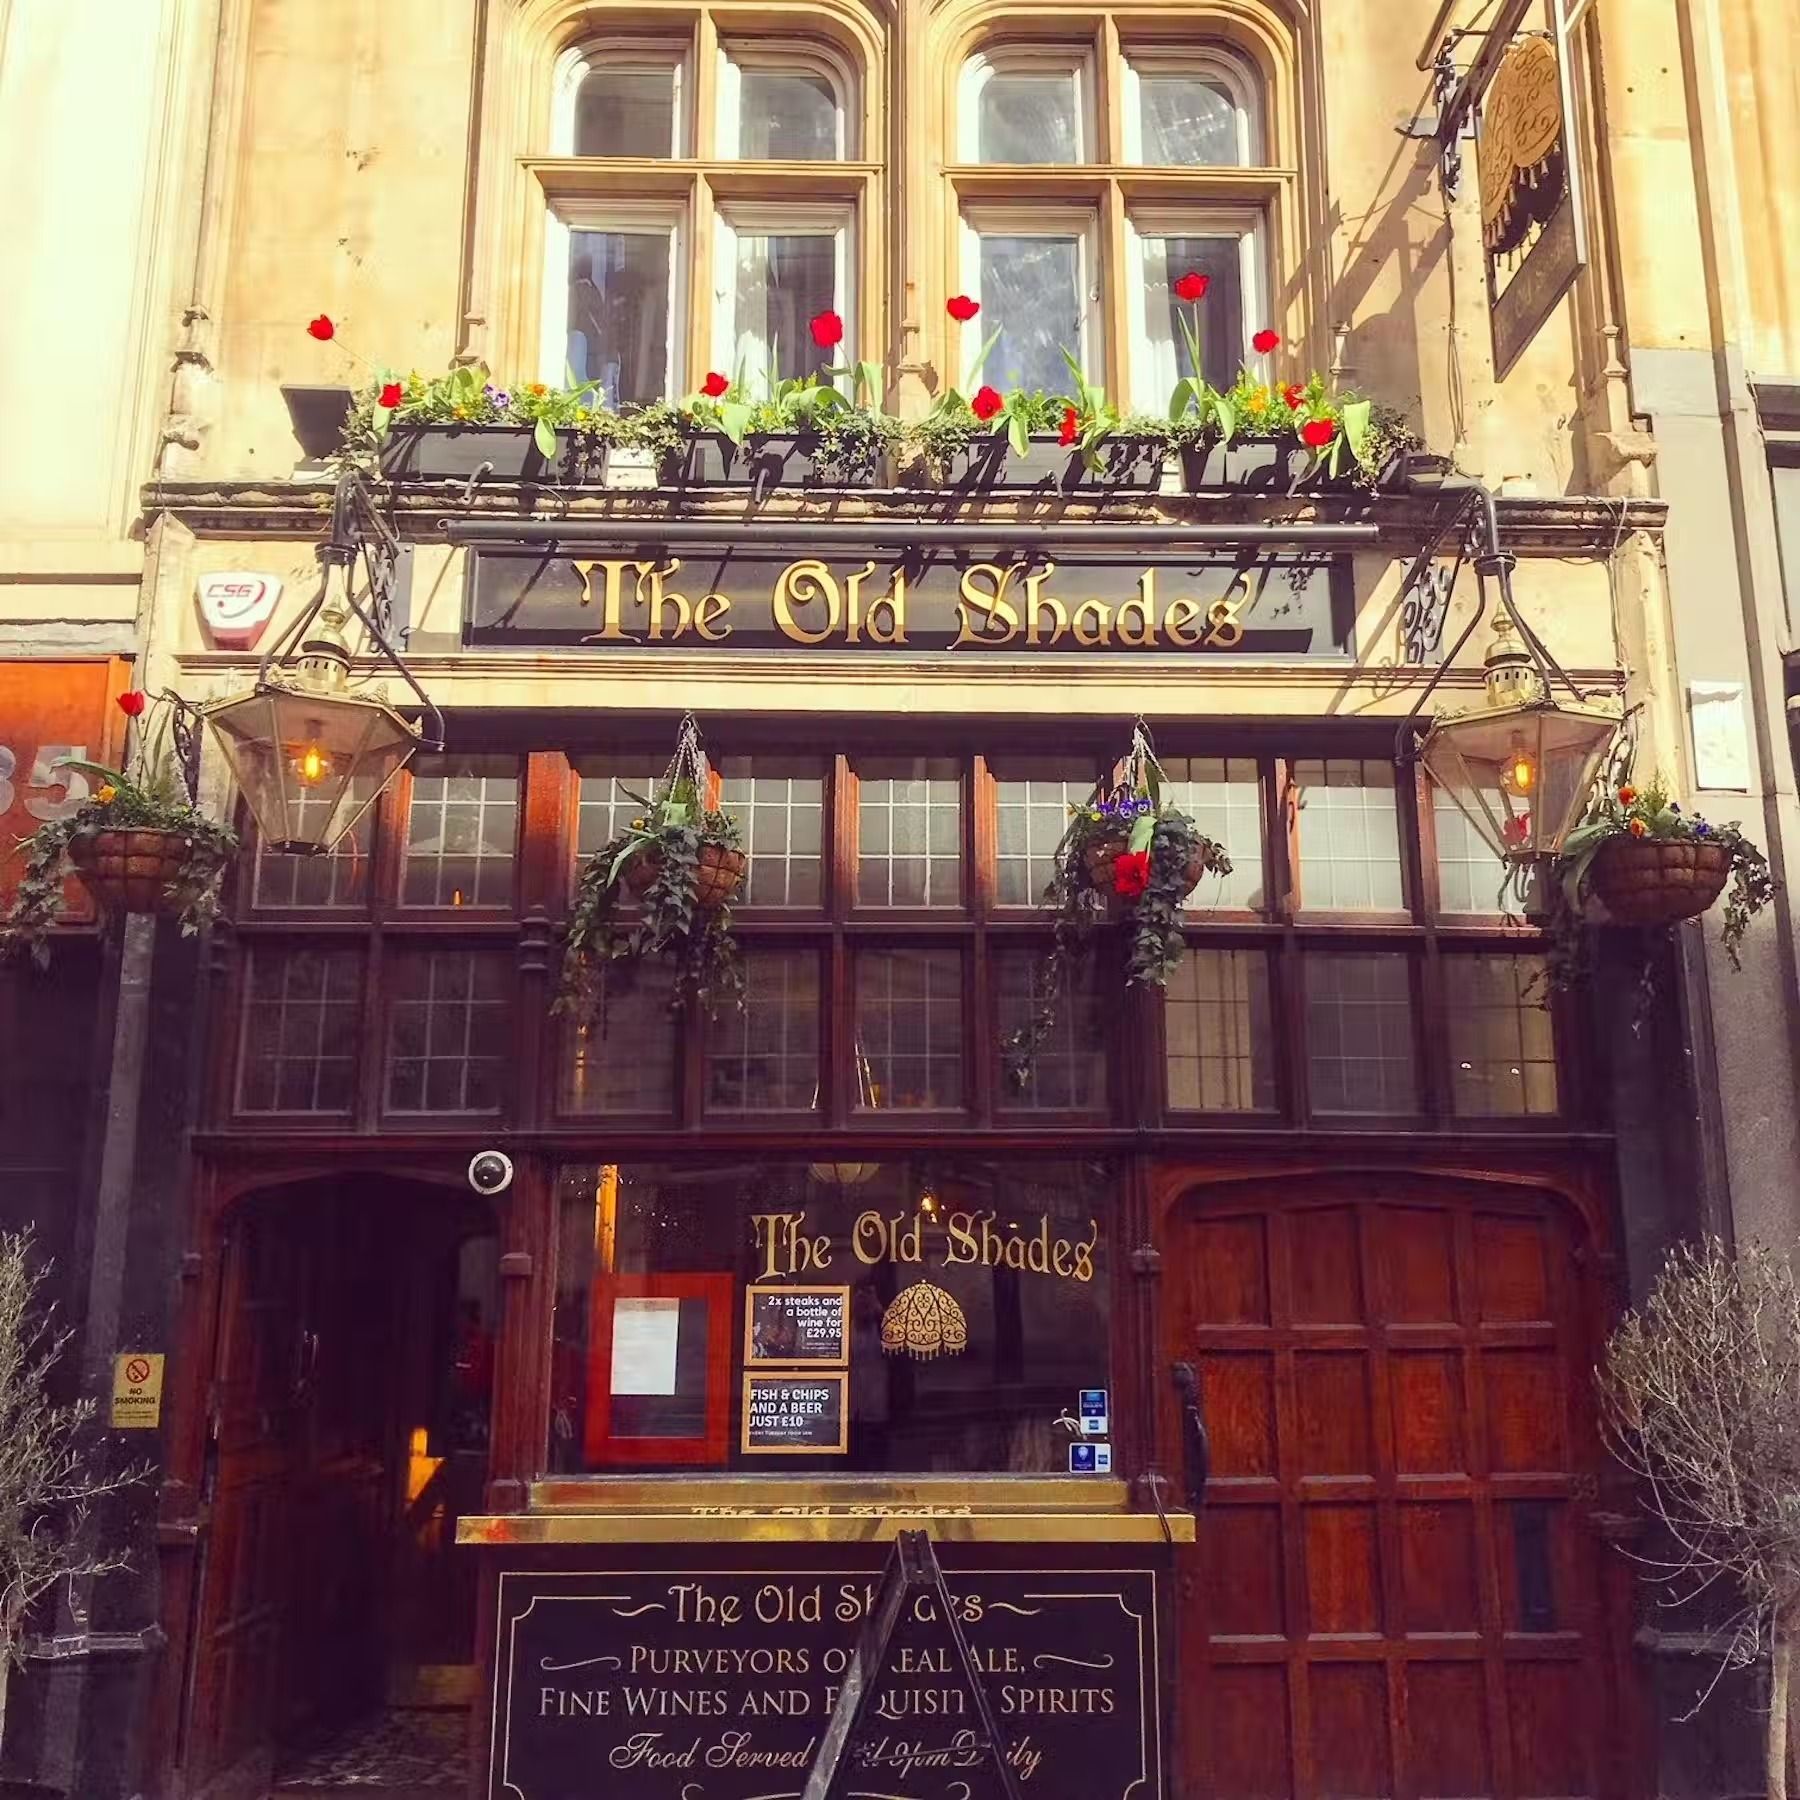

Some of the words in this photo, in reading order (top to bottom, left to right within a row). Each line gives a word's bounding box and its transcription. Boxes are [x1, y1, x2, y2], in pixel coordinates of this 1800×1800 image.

[572, 557, 733, 644] The
[773, 559, 909, 644] Old
[946, 561, 1251, 650] Shades
[751, 1211, 832, 1283] The
[852, 1210, 923, 1264] Old
[941, 1209, 1098, 1283] Shades
[768, 1295, 782, 1306] 2x
[784, 1295, 820, 1306] steaks
[821, 1295, 843, 1306] and
[786, 1308, 794, 1317] a
[796, 1306, 828, 1317] bottle
[830, 1306, 843, 1317] of
[796, 1317, 823, 1327] wine
[825, 1317, 843, 1327] for
[806, 1327, 842, 1338] £29.95
[129, 1387, 143, 1396] NO
[750, 1388, 778, 1401] FISH
[780, 1388, 790, 1401] &
[791, 1388, 830, 1401] CHIPS
[114, 1396, 156, 1405] SMOKING
[749, 1402, 777, 1414] AND
[778, 1402, 788, 1414] A
[790, 1402, 823, 1414] BEER
[749, 1415, 780, 1427] JUST
[781, 1415, 804, 1427] £10
[667, 1583, 743, 1627] The
[755, 1583, 822, 1623] Old
[630, 1645, 810, 1674] PURVEYORS
[539, 1687, 611, 1716] FINE
[623, 1687, 728, 1716] WINES
[738, 1690, 812, 1716] AND
[1000, 1685, 1115, 1714] SPIRITS
[608, 1731, 702, 1769] Food
[705, 1730, 817, 1768] Served
[951, 1728, 1042, 1780] Dily
